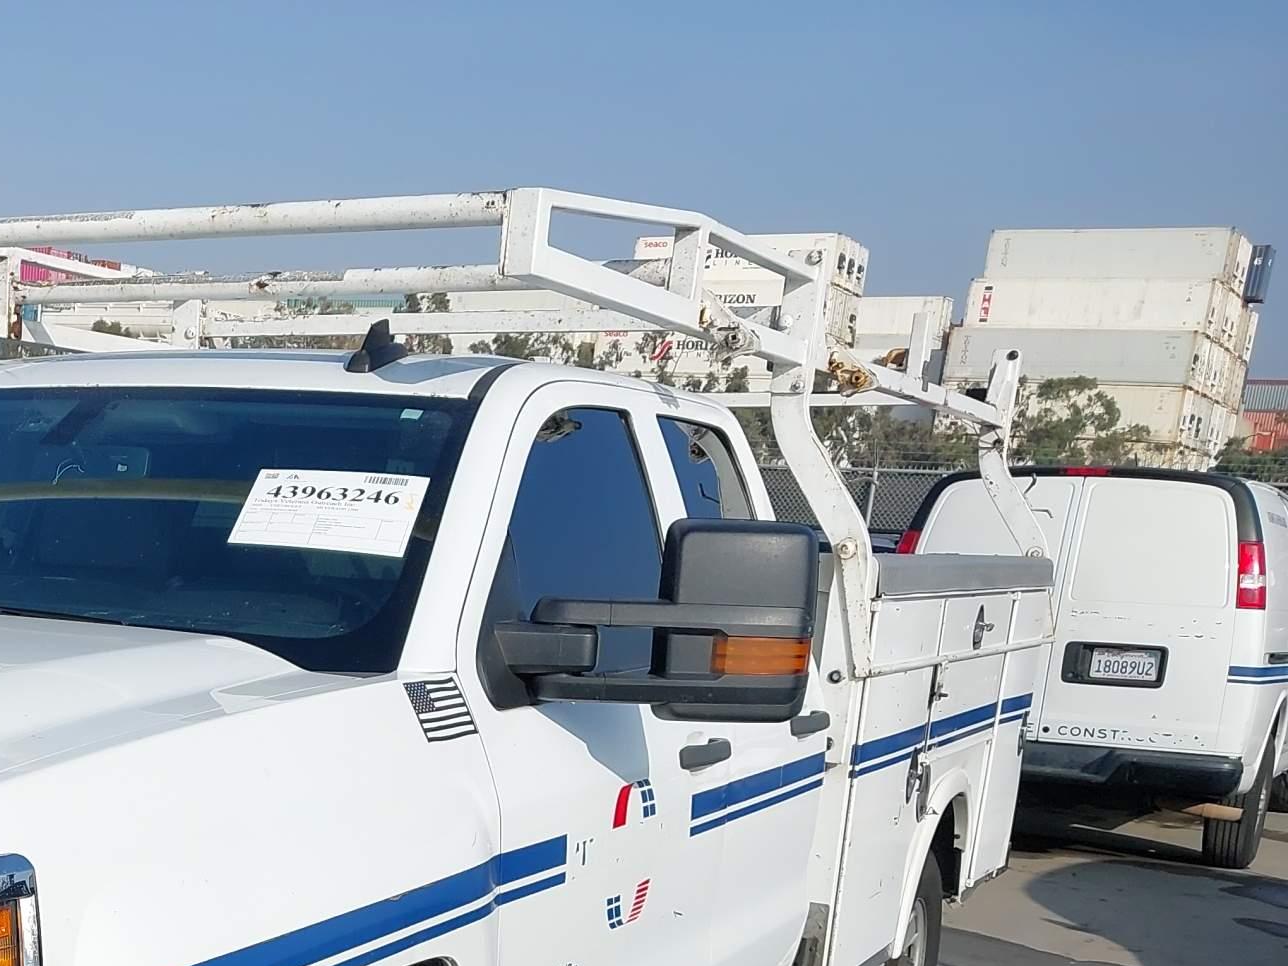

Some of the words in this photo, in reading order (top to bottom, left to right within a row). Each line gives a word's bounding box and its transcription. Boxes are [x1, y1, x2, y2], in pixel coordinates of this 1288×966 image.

[715, 294, 757, 304] RIZON
[266, 484, 400, 505] 43963246
[1094, 659, 1154, 676] 18089U2
